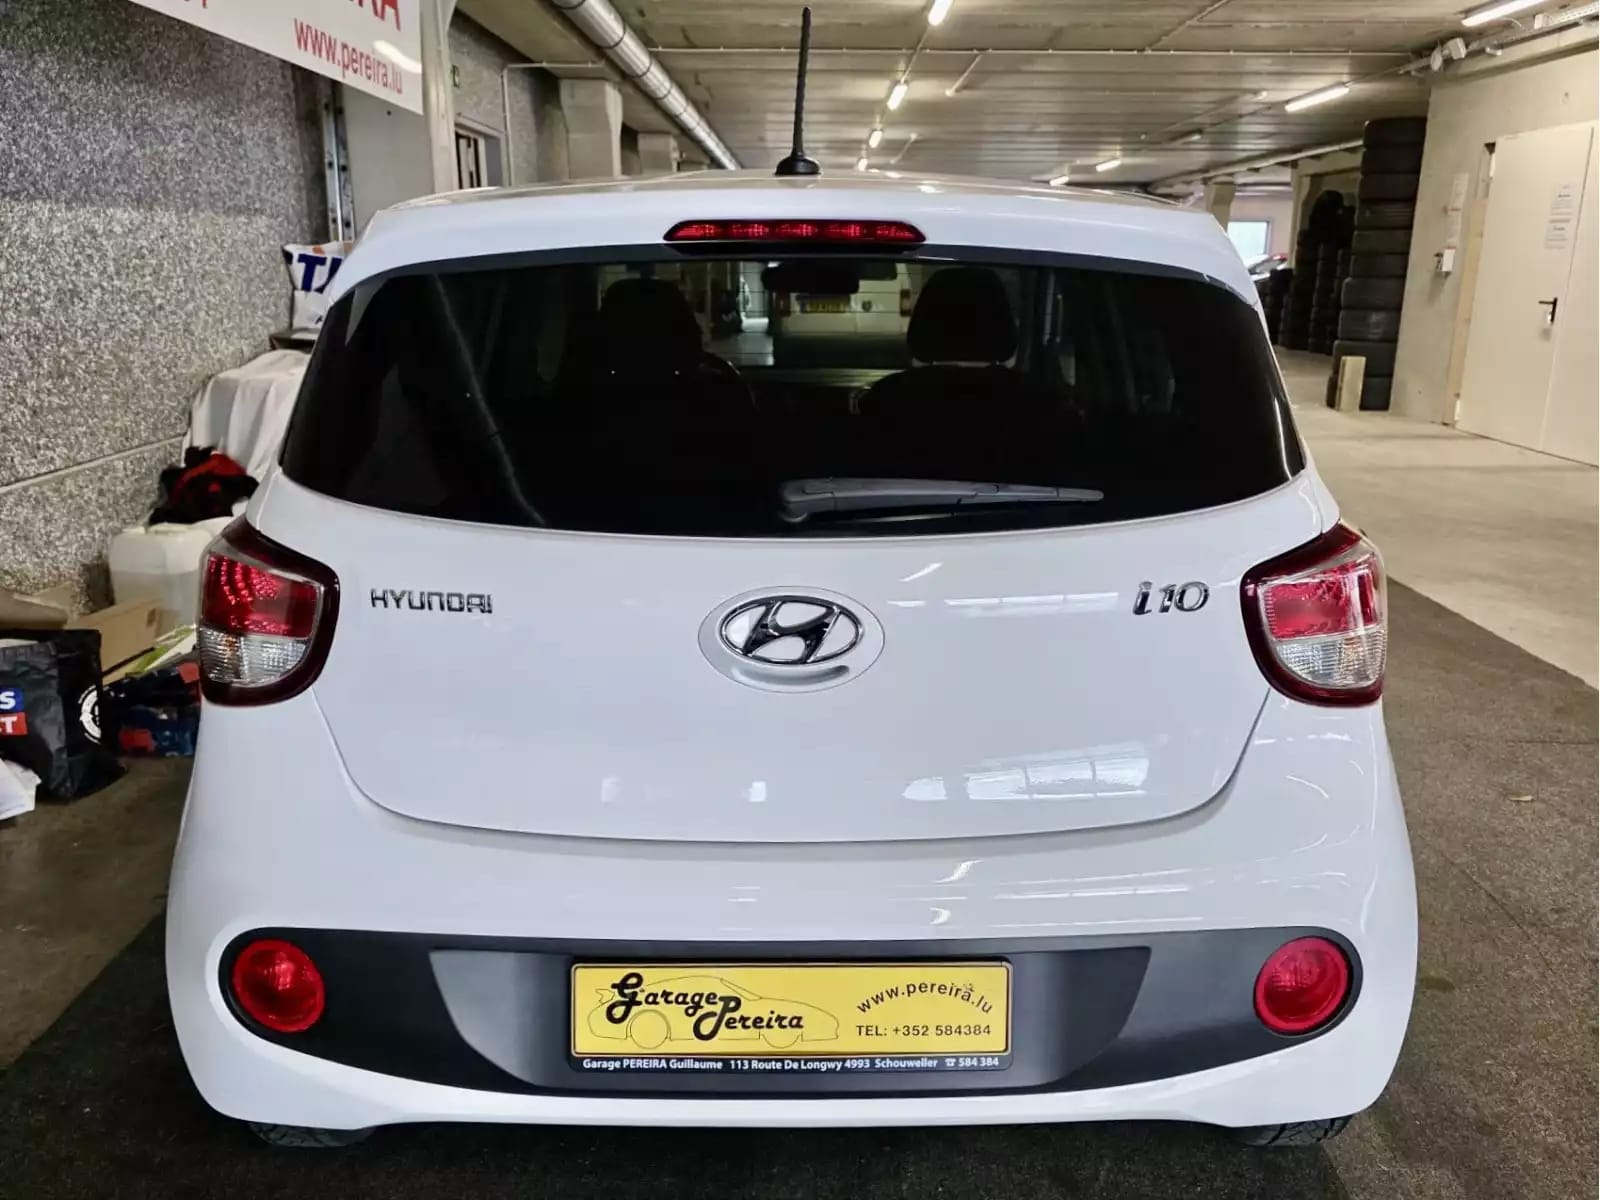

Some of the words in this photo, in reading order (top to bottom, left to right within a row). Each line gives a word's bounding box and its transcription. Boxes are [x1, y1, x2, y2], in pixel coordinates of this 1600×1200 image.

[293, 17, 403, 94] www.pereira.lu
[370, 588, 493, 614] HYUNDAI
[1132, 581, 1209, 615] i10
[606, 972, 719, 1024] Garage
[856, 982, 993, 1014] www.pereira.lu
[693, 996, 804, 1041] Pereira
[856, 1024, 888, 1036] TEL:
[892, 1024, 930, 1037] +352
[935, 1024, 992, 1036] 584384
[583, 1059, 621, 1070] Garage
[623, 1058, 668, 1069] PEREIRA
[669, 1058, 723, 1070] Guillaume
[729, 1059, 749, 1070] 113
[751, 1059, 782, 1070] Route
[784, 1059, 799, 1070] De
[801, 1058, 842, 1071] Longwy
[844, 1058, 871, 1069] 4993
[958, 1056, 978, 1067] 584
[979, 1056, 1000, 1067] 384
